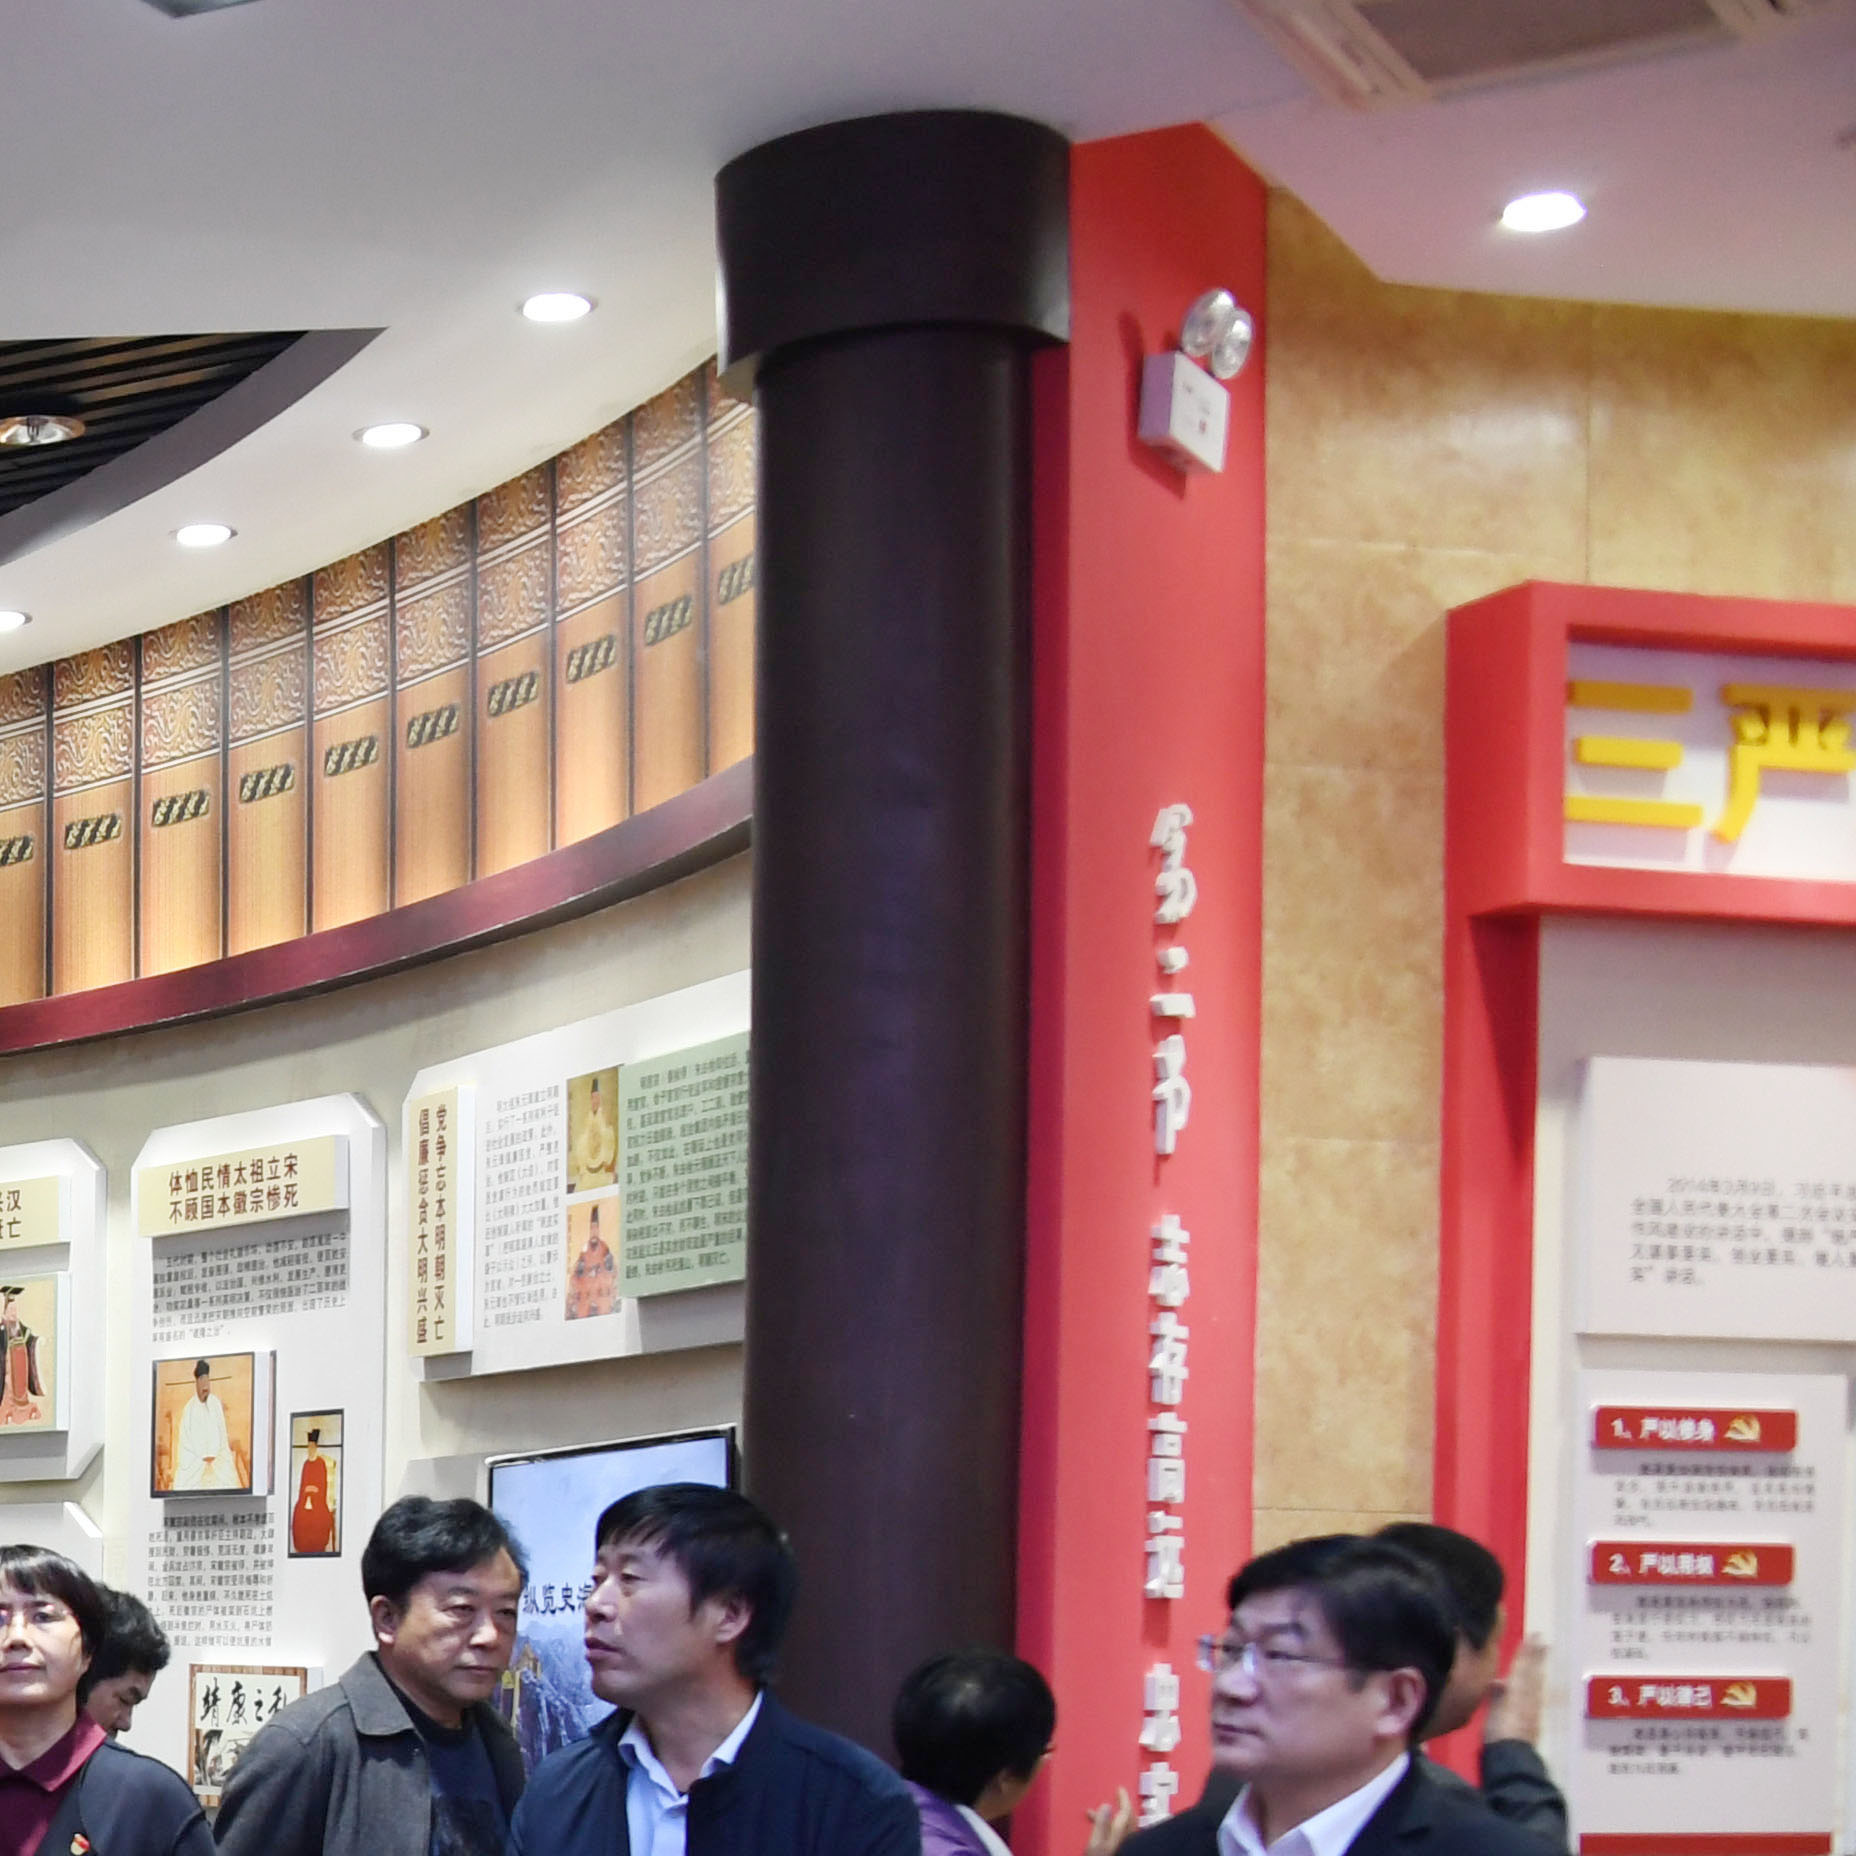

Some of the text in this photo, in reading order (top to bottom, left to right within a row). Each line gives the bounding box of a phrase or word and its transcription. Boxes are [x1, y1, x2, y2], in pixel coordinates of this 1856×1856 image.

[169, 1152, 298, 1197] 体恤民情太祖立宋
[169, 1183, 299, 1225] 不顾国本徽宗惨死
